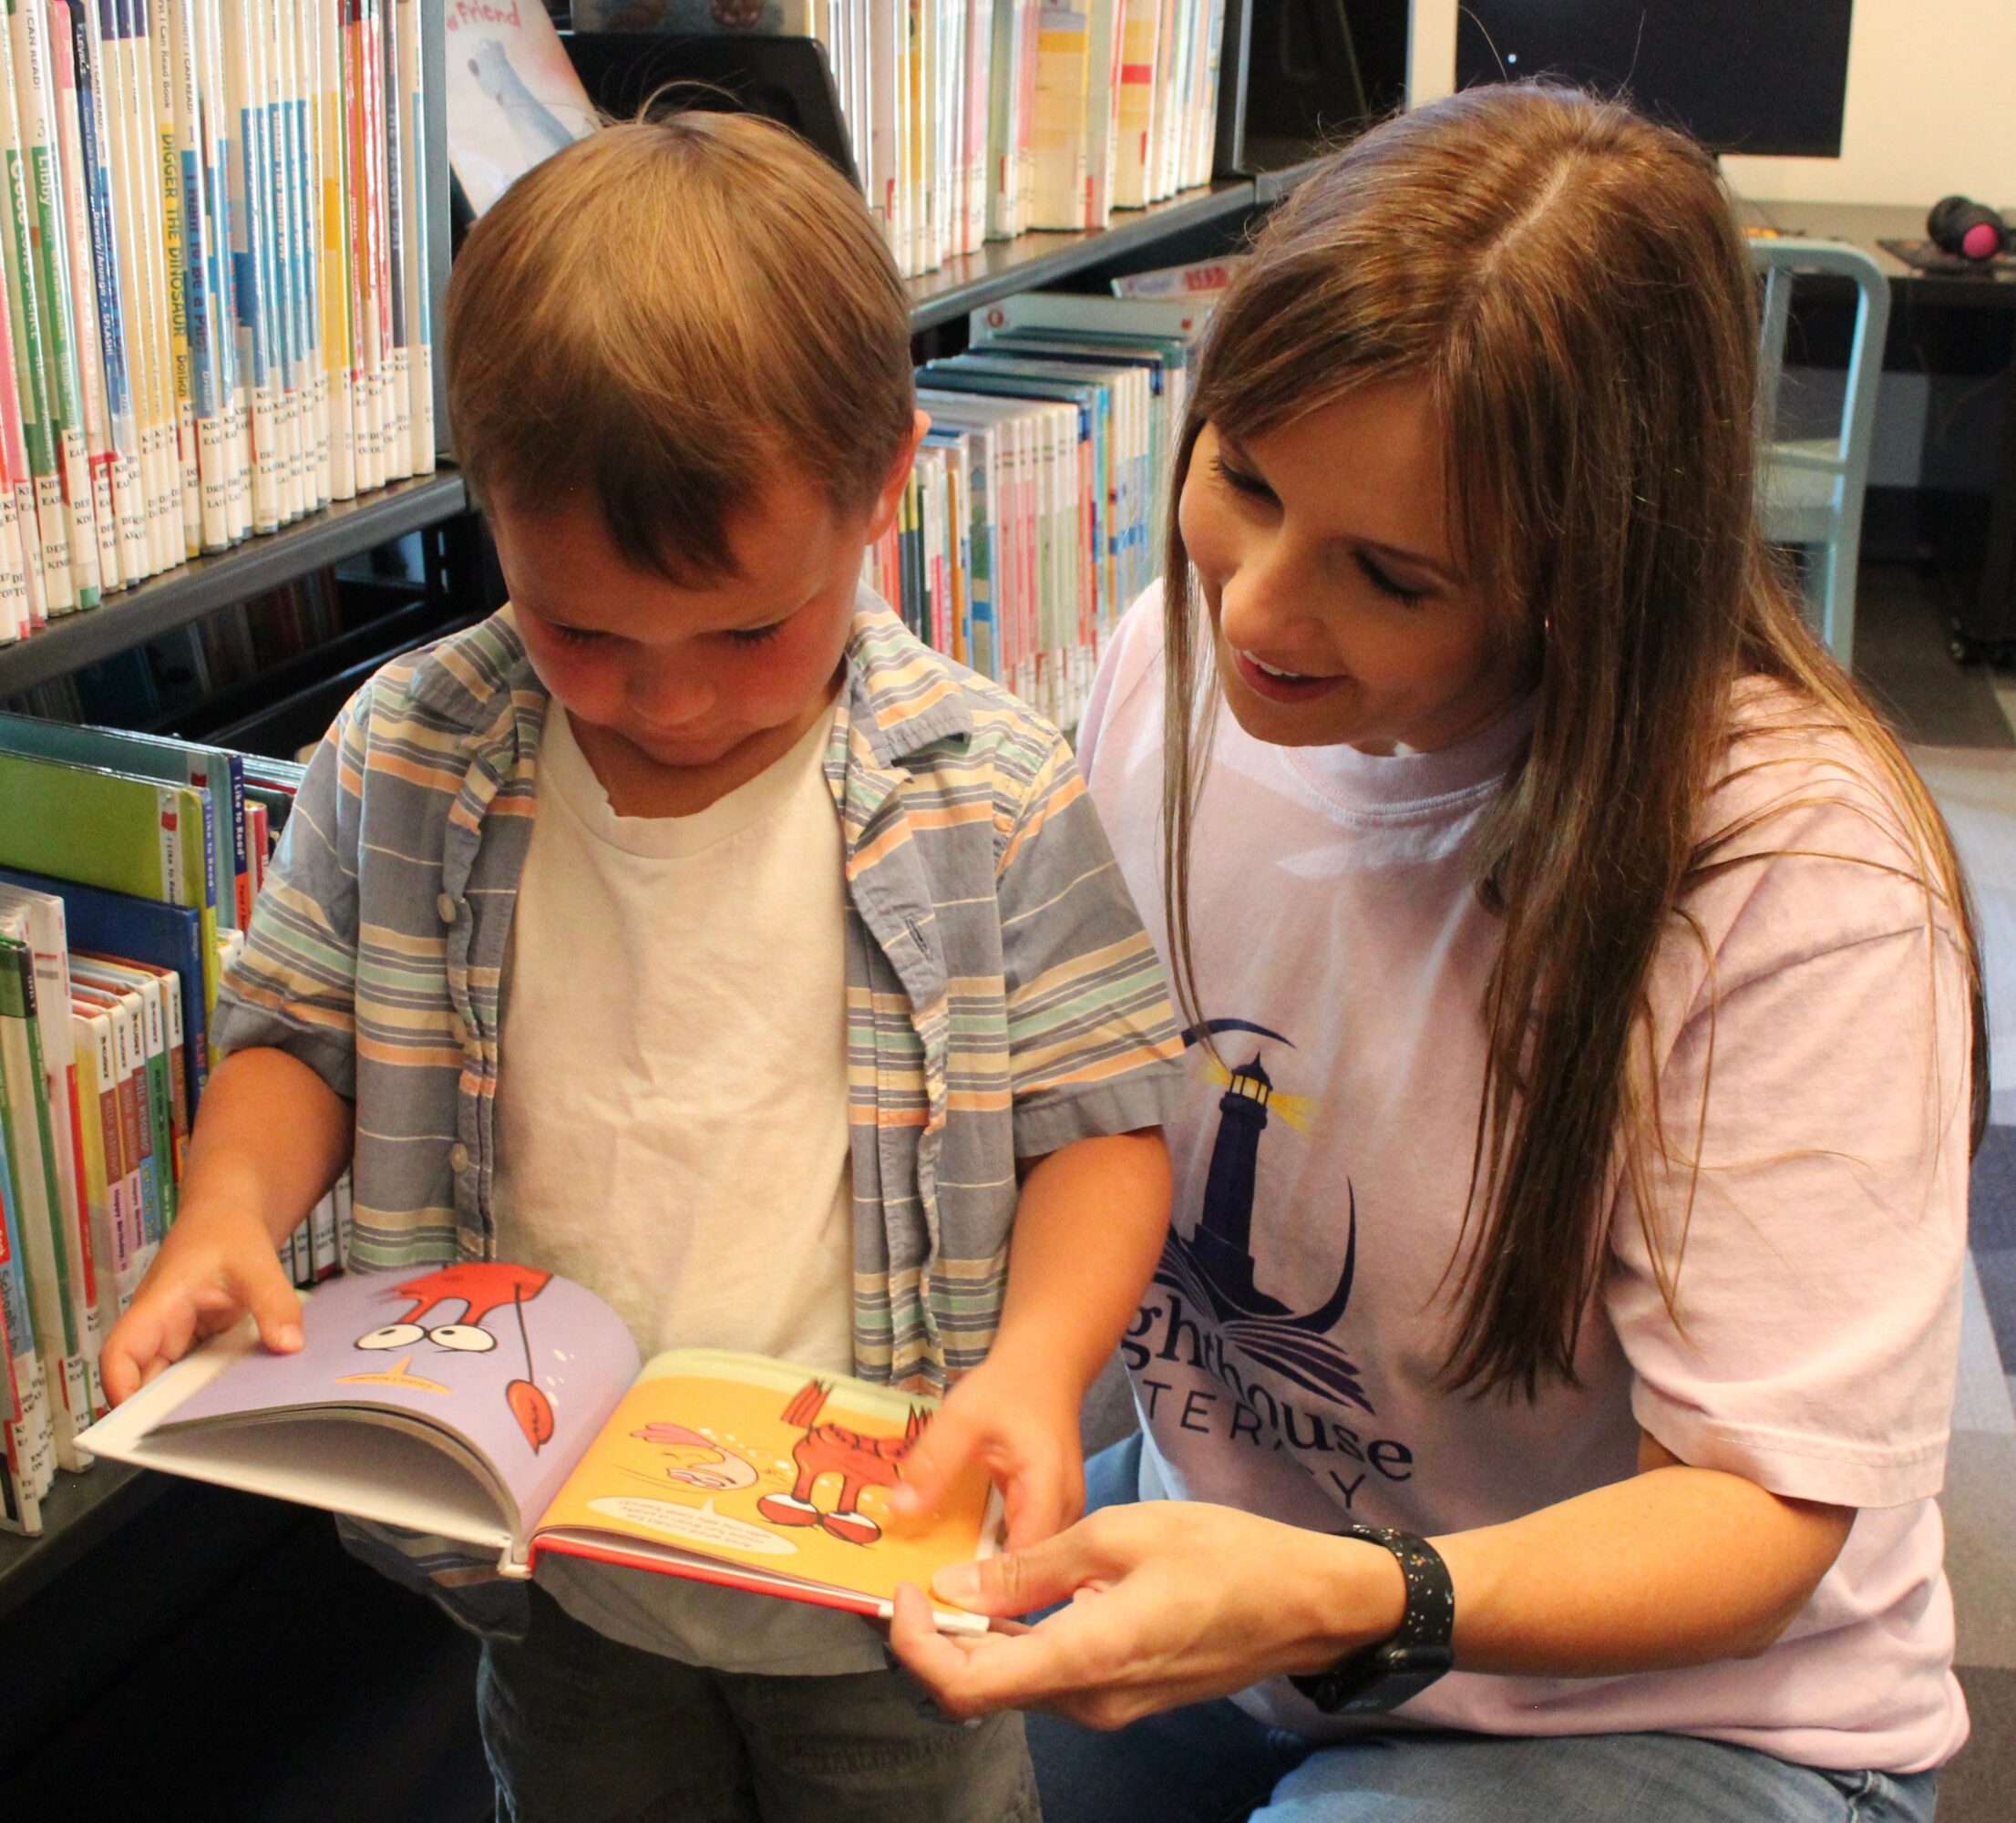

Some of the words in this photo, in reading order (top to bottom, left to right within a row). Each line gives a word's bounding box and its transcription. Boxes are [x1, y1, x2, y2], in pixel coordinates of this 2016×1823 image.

[457, 1, 520, 27] Friend
[26, 17, 36, 45] CAN
[160, 26, 169, 46] Can
[30, 46, 41, 90] READ!
[161, 50, 170, 77] Read
[184, 58, 192, 81] CAN
[163, 81, 171, 108] Book
[185, 84, 193, 114] READ!
[38, 154, 53, 205] Libby
[160, 134, 178, 198] DIGGER
[166, 210, 180, 240] THE
[168, 247, 186, 337] DINOSAUR
[103, 313, 114, 355] SPLASH!
[234, 784, 243, 809] Like
[235, 812, 243, 823] to
[207, 842, 214, 854] to
[168, 869, 175, 879] to
[114, 1189, 122, 1218] Happy
[116, 1220, 125, 1262] Birthday,
